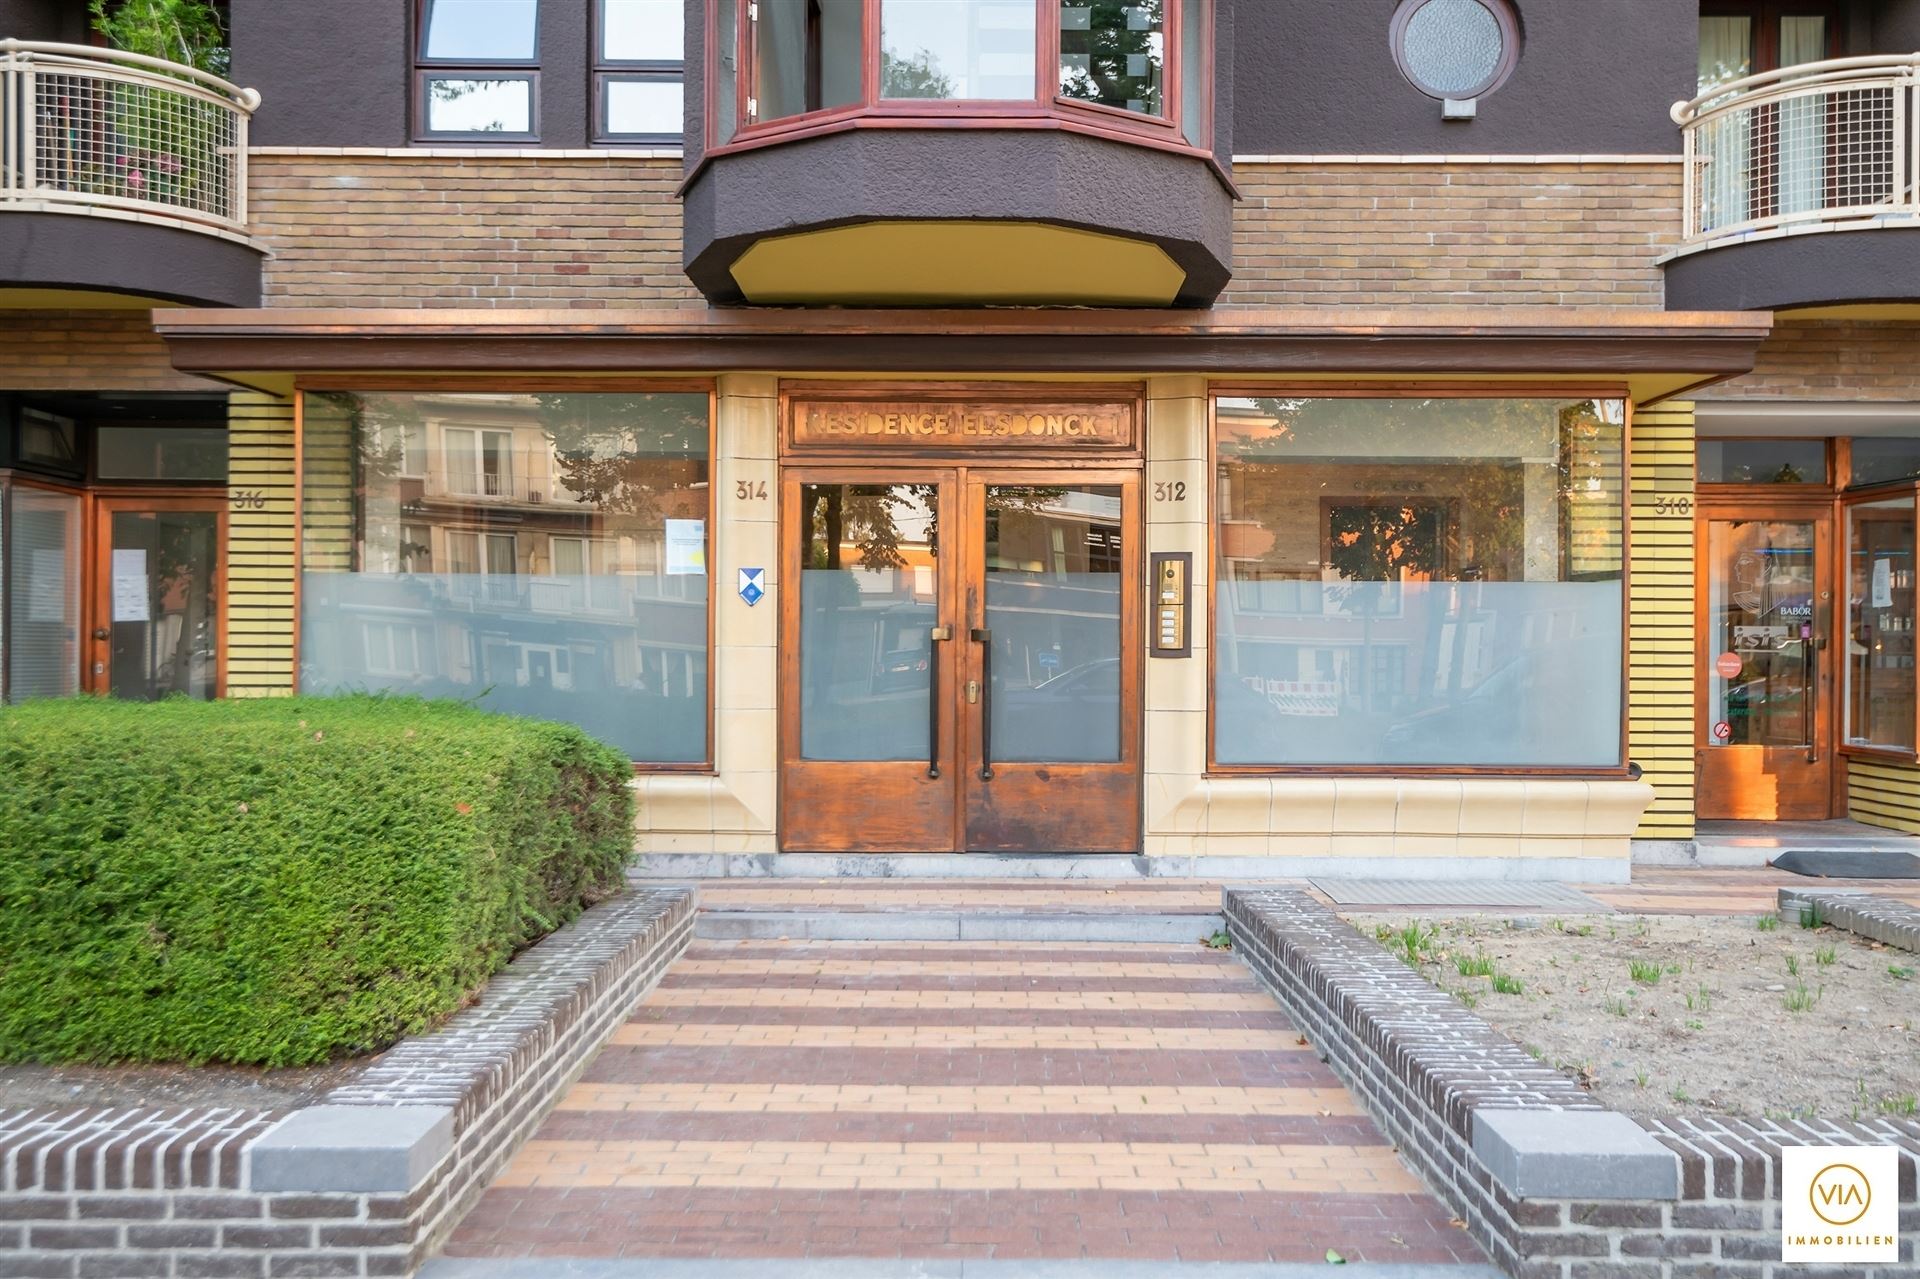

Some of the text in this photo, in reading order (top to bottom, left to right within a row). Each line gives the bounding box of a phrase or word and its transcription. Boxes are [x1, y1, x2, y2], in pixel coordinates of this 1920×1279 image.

[807, 412, 949, 435] RESIDENCE
[962, 414, 1098, 436] ELSDONCK
[235, 490, 264, 509] 316
[736, 480, 768, 500] 314
[1154, 481, 1186, 502] 312
[1656, 497, 1689, 515] 310
[1780, 606, 1812, 617] BABOR
